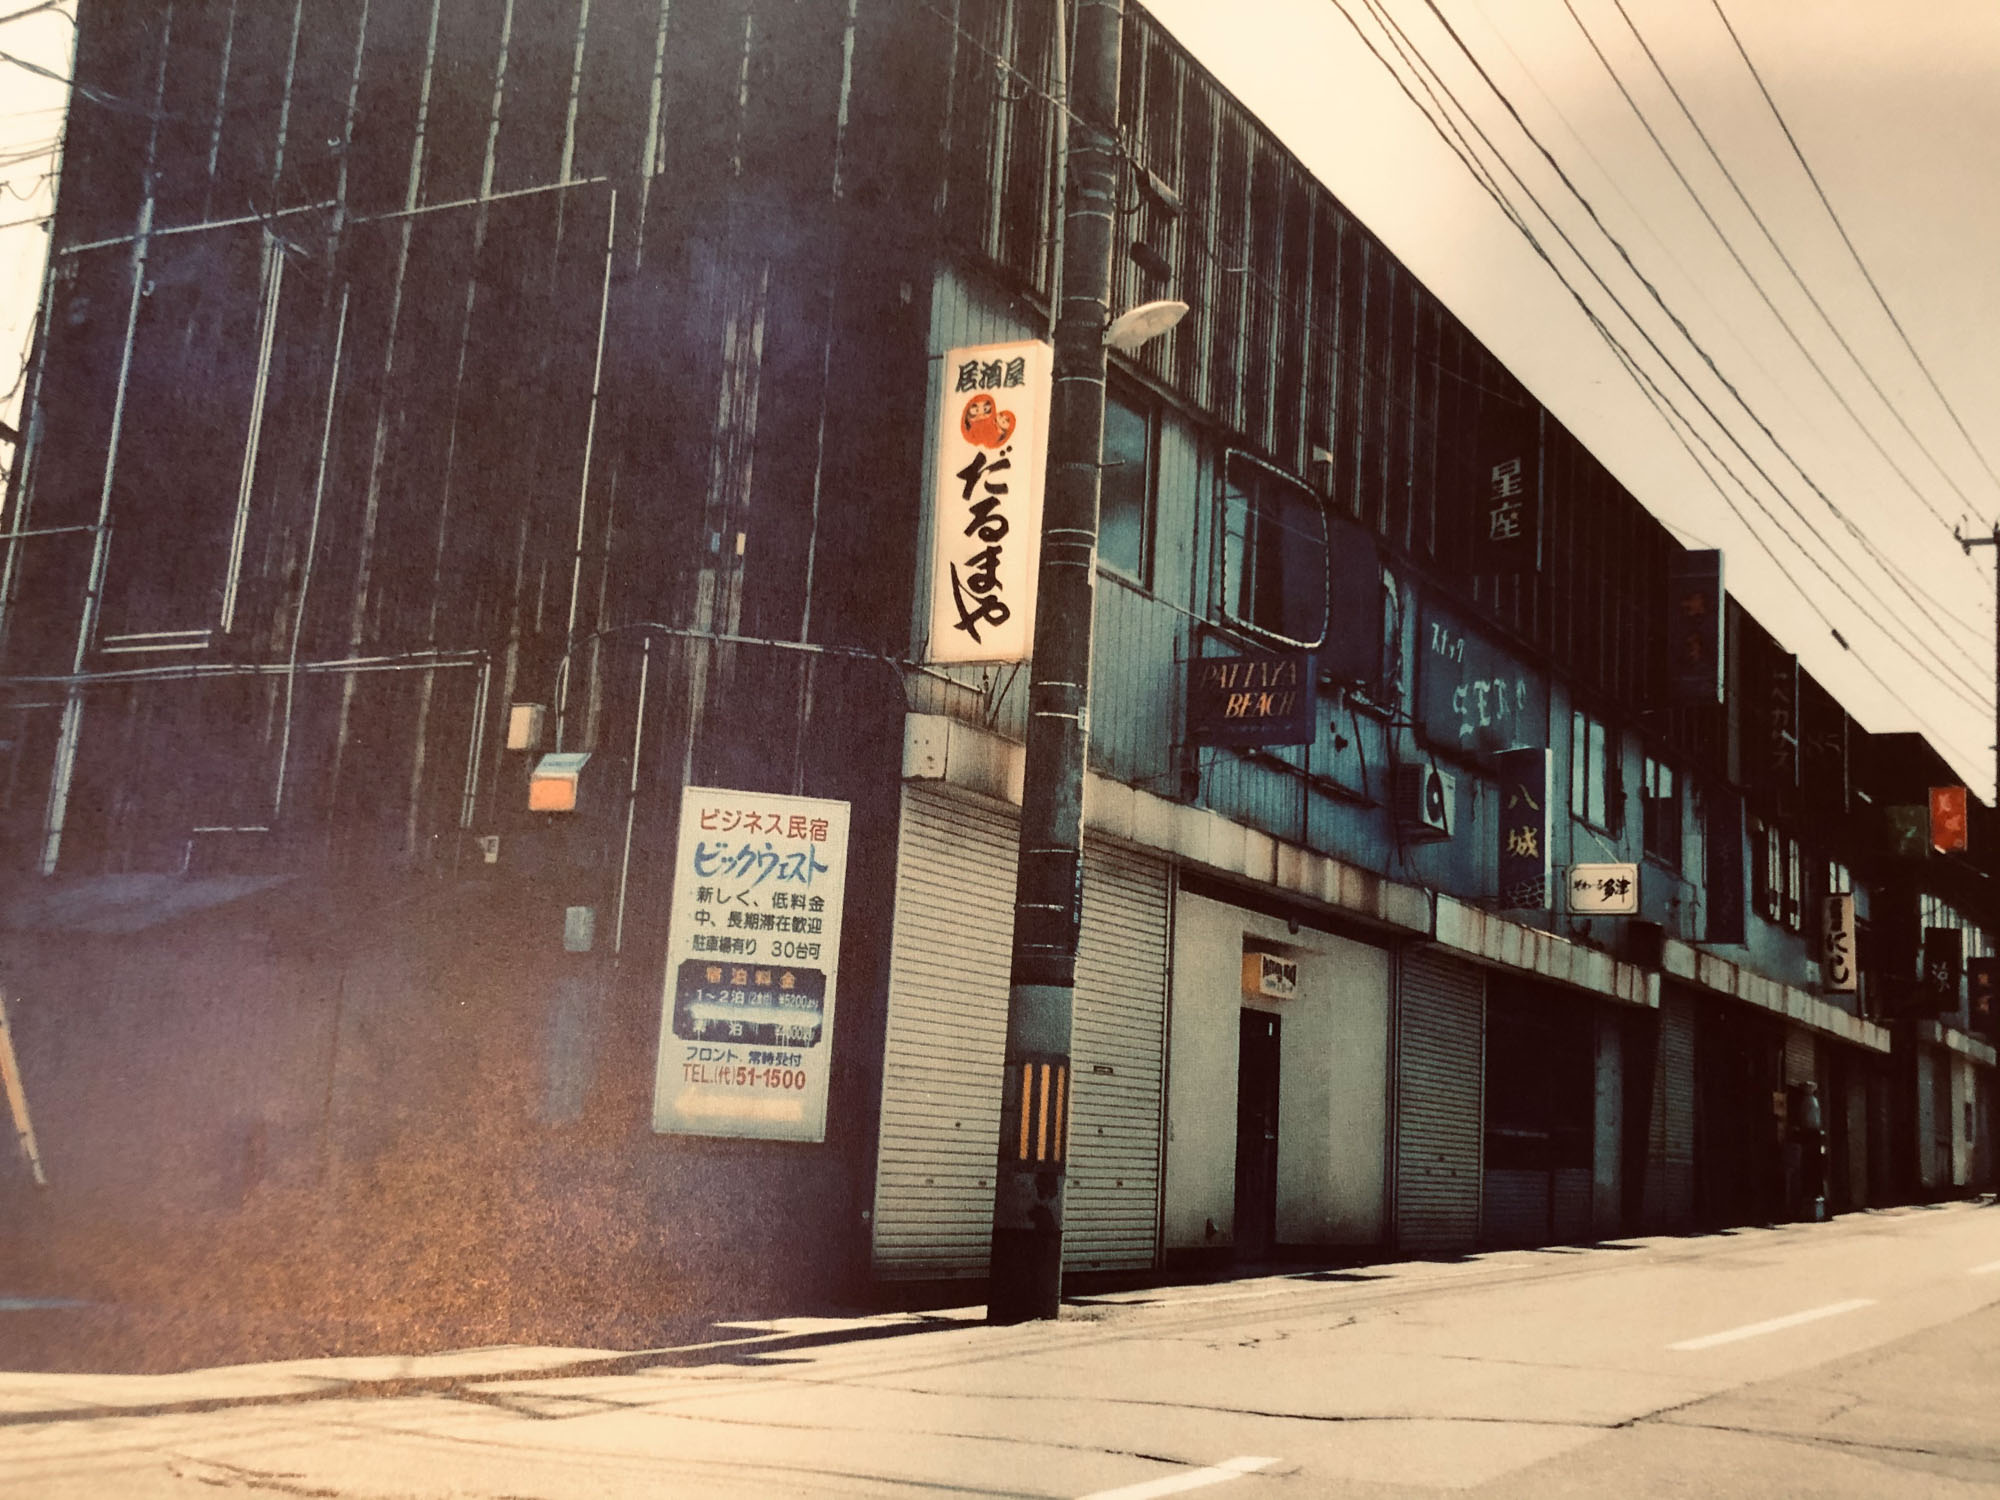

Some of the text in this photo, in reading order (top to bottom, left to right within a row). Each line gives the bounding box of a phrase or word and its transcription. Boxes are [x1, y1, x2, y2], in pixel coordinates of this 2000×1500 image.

[955, 357, 1026, 392] 居酒屋
[1489, 456, 1523, 541] 星座
[950, 444, 1012, 645] だるまや
[700, 808, 829, 842] ビジネス民宿
[771, 941, 821, 960] 30台可
